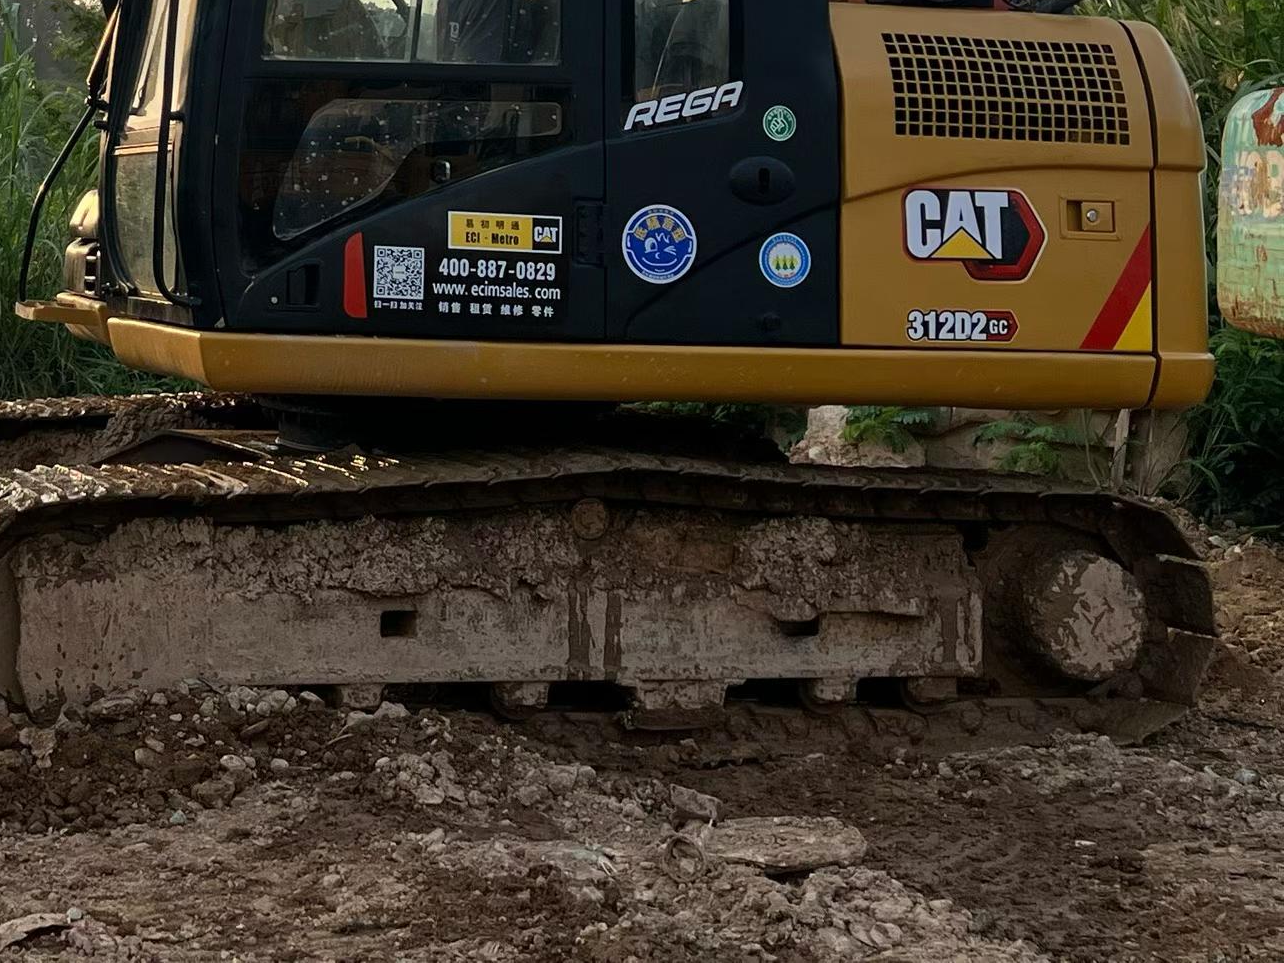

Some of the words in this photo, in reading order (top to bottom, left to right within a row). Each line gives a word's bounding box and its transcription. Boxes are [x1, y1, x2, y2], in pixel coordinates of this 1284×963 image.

[624, 81, 743, 130] REGA
[534, 226, 558, 242] CAT
[905, 190, 1009, 259] CAT
[465, 232, 481, 243] ECI
[491, 233, 519, 245] Metro
[439, 258, 556, 280] 400-887-0829
[908, 311, 987, 340] 312D2
[989, 320, 1008, 334] GC
